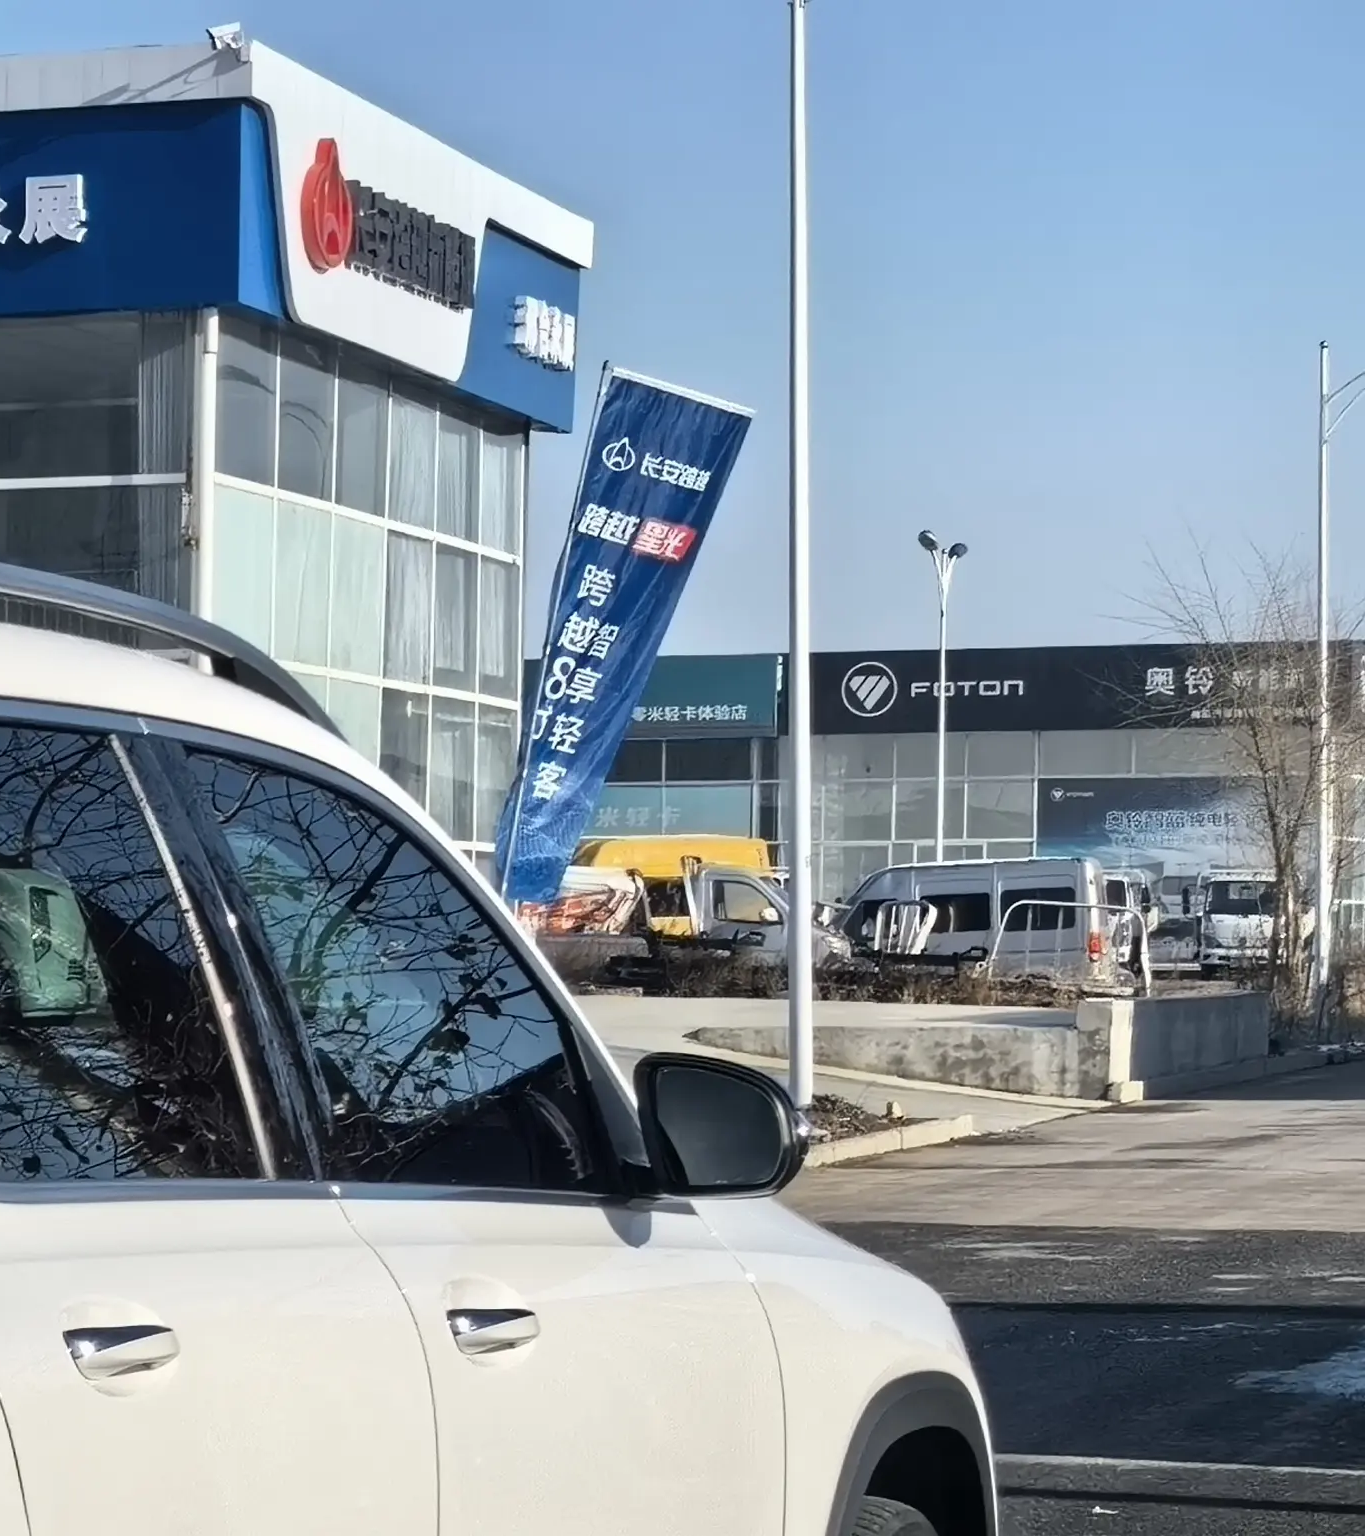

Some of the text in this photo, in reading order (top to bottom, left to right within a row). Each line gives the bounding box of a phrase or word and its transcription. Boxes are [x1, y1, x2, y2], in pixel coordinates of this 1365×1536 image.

[640, 452, 712, 492] 长安跨越
[909, 678, 1025, 697] FOTON
